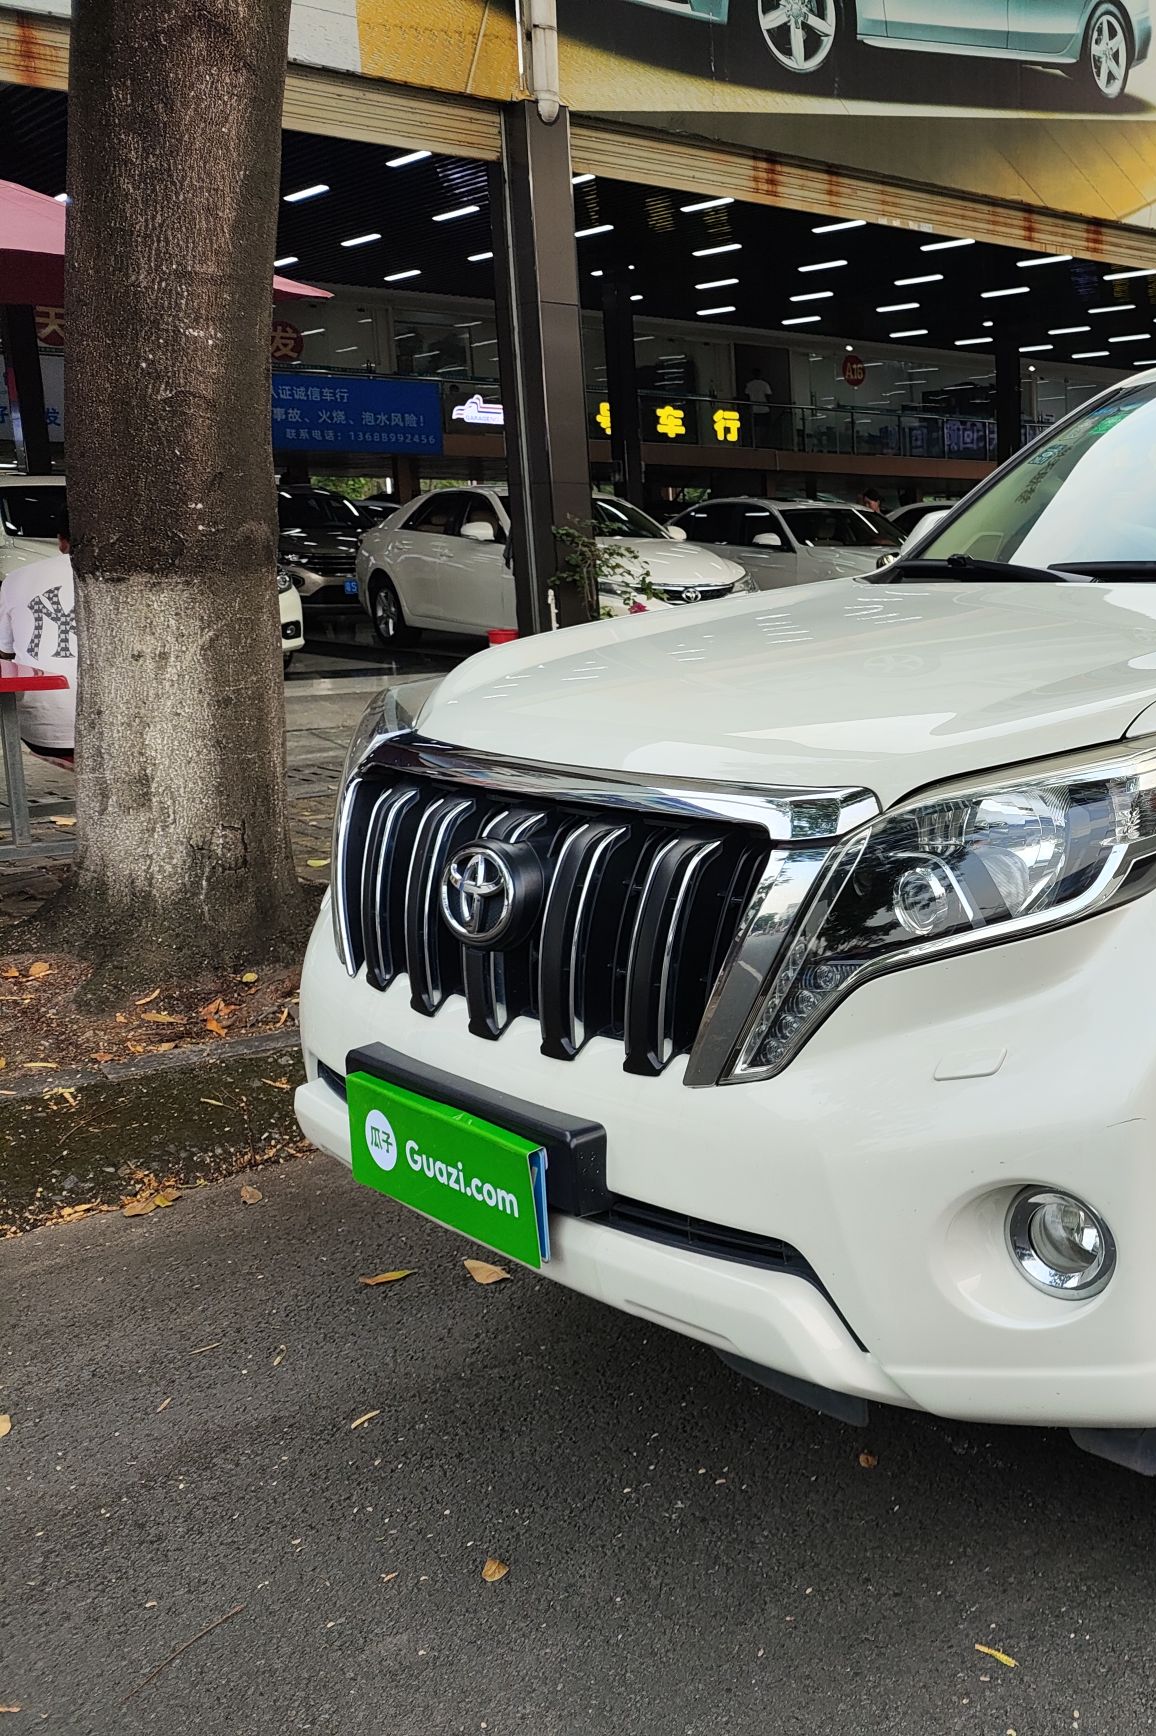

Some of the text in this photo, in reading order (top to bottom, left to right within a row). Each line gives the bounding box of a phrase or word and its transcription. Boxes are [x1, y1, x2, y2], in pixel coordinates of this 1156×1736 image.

[846, 363, 864, 380] A16
[370, 1125, 393, 1154] 瓜子
[405, 1139, 519, 1218] Guazi.com
